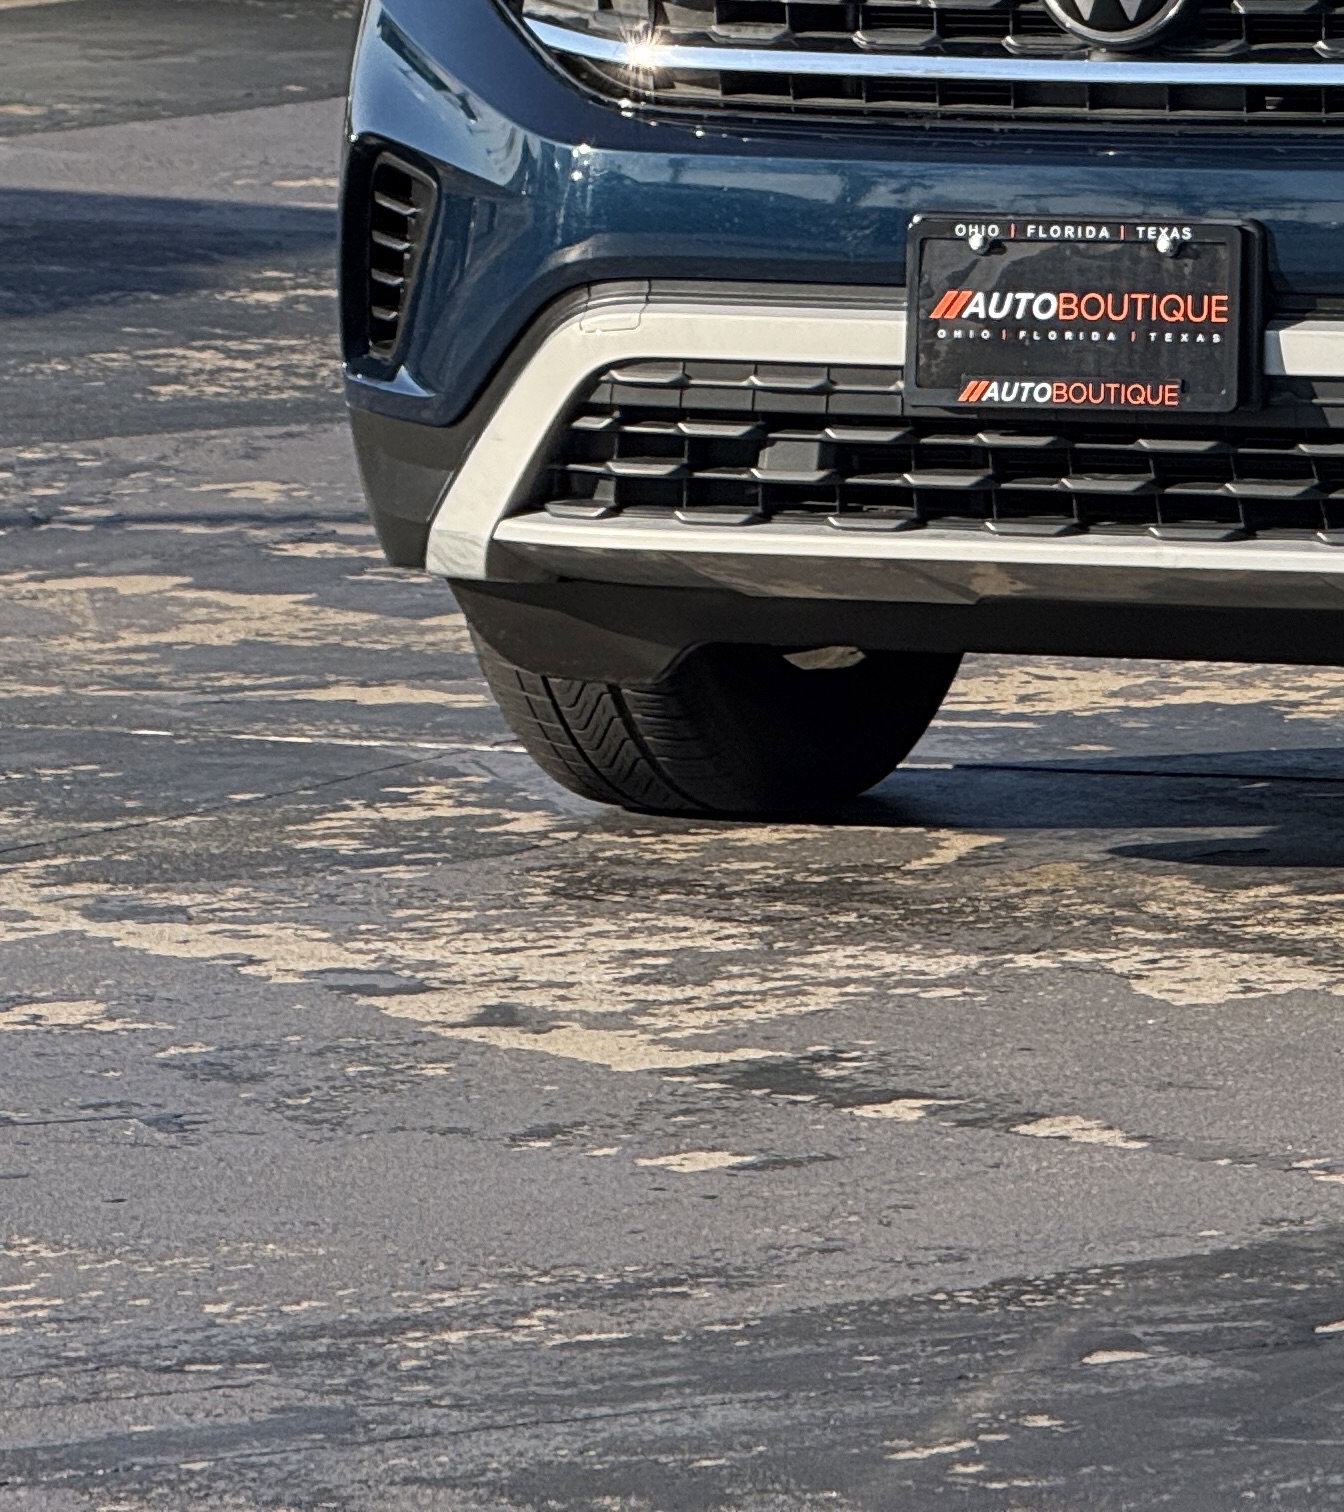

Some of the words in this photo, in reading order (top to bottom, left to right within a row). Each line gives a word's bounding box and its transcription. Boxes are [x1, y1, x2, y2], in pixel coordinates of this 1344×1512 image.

[955, 223, 1000, 239] OHIO
[1027, 224, 1110, 239] FLORIDA
[1136, 225, 1192, 240] TEXAS
[937, 328, 991, 340] OHIO
[1019, 329, 1117, 341] FLORIDA
[1150, 331, 1221, 344] TEXAS
